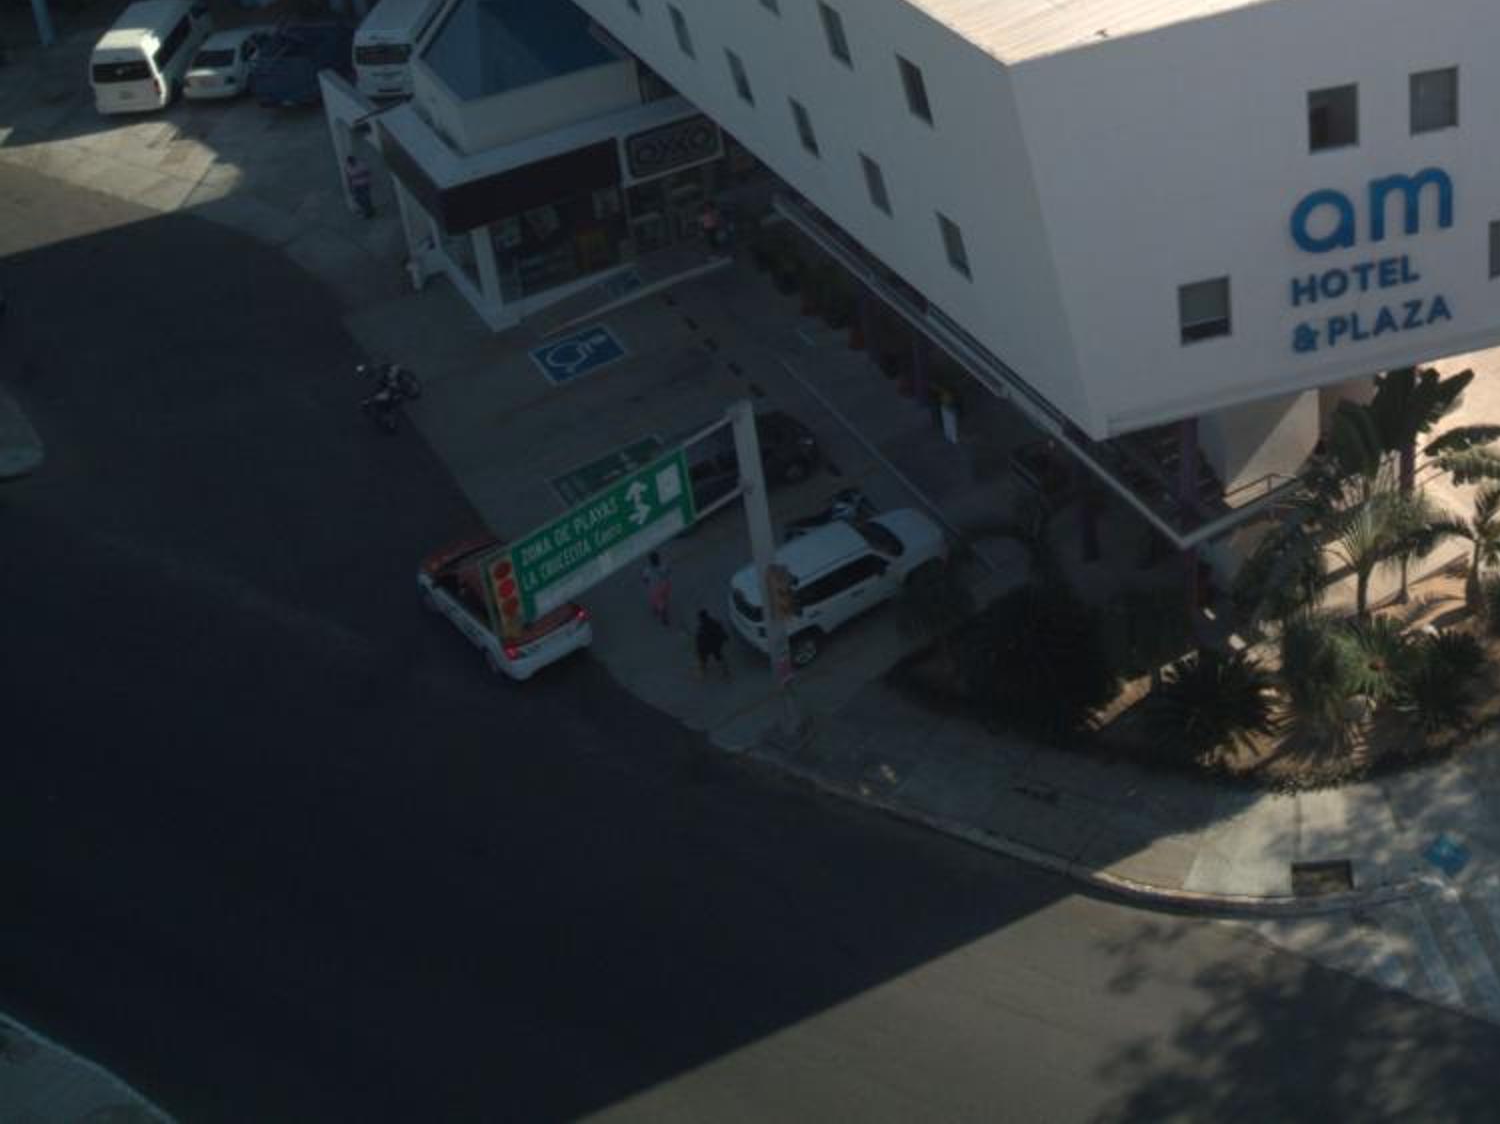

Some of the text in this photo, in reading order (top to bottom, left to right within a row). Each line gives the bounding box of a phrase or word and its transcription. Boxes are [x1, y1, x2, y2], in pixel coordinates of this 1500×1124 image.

[1290, 167, 1454, 254] am
[1291, 255, 1420, 307] HOTEL
[1291, 295, 1453, 353] & PLAZA
[553, 523, 572, 547] DE
